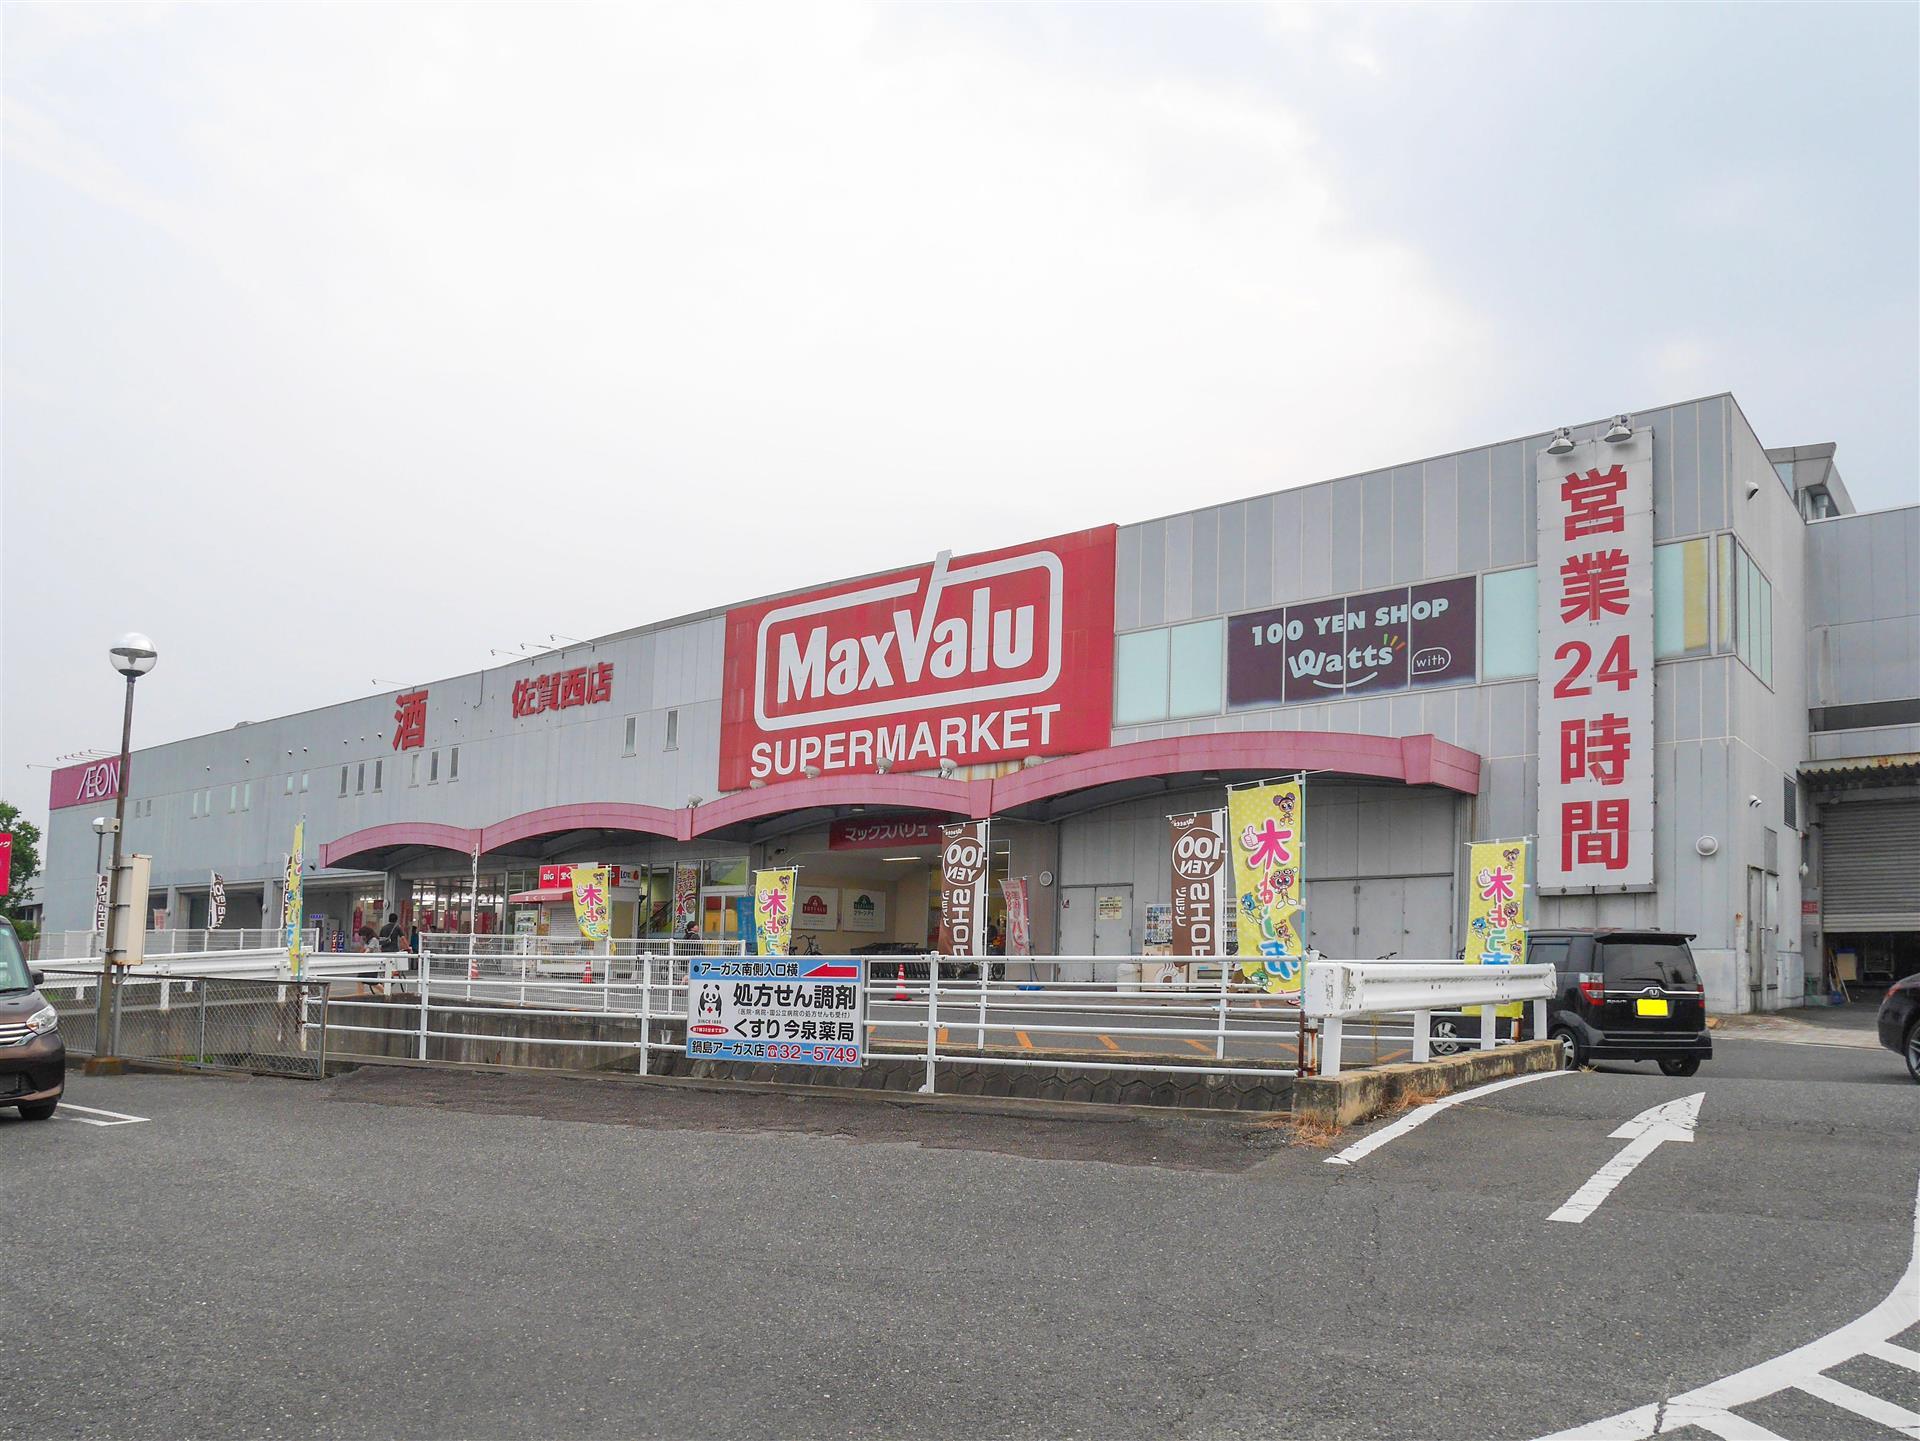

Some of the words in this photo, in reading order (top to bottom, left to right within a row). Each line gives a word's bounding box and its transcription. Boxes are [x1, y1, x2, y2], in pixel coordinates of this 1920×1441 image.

[777, 550, 1034, 703] MaxValu
[1252, 619, 1304, 646] 100
[1314, 610, 1366, 636] YEN
[1374, 598, 1449, 627] SHOP
[1288, 644, 1393, 679] Watts
[1416, 653, 1446, 668] with
[1553, 463, 1638, 872] 営業24時間
[512, 662, 614, 719] 佐賀西店
[392, 689, 428, 751] 酒
[751, 704, 1061, 779] SUPERMARKET
[845, 824, 928, 842] マックスバリュ
[701, 962, 799, 977] アーガス南側入口横
[733, 983, 857, 1010] 処方せん調剤
[692, 1040, 765, 1057] 鍋島アーガス店
[779, 1044, 858, 1063] 32-5749
